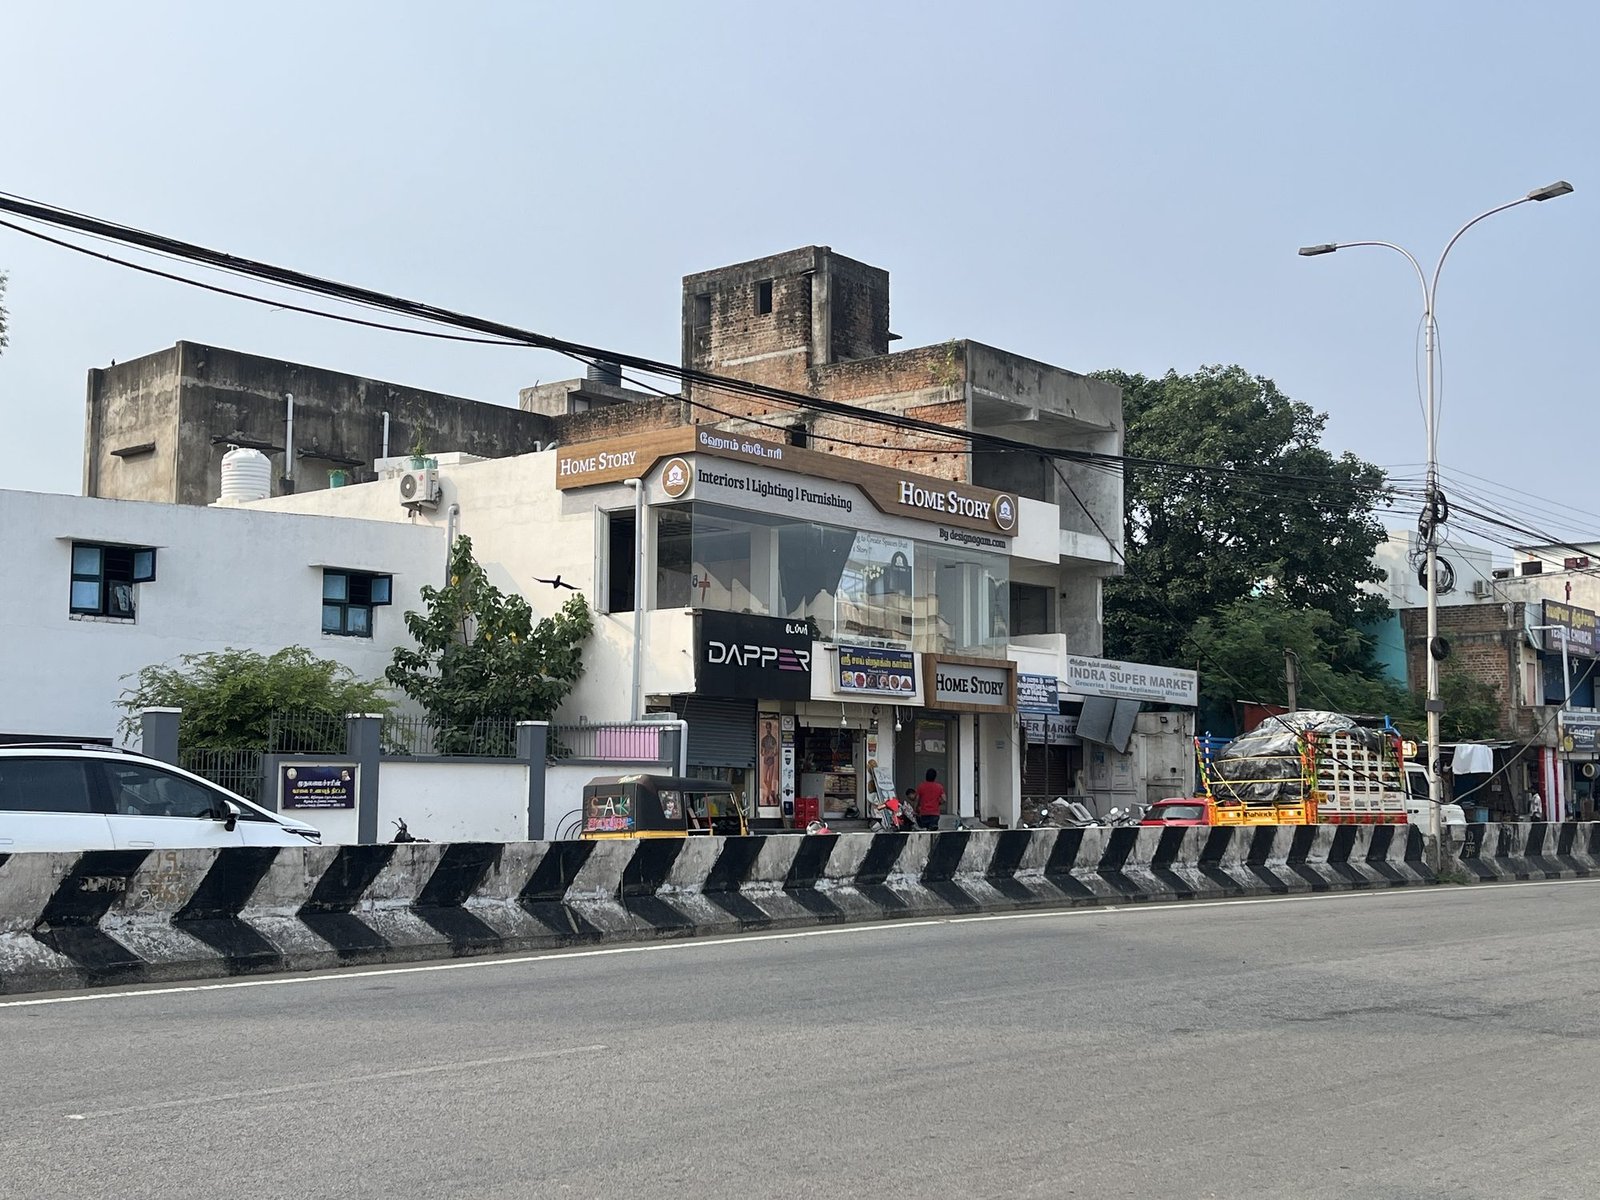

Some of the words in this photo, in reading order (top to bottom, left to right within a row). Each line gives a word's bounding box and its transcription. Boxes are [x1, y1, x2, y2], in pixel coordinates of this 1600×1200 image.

[700, 432, 739, 451] ஹோம்
[741, 441, 782, 460] ஸ்டோரி
[698, 469, 744, 490] Interiors
[752, 479, 794, 502] Lighting
[801, 489, 852, 513] Furnishing
[939, 528, 949, 541] By
[950, 529, 1006, 548] designogam.com
[708, 640, 810, 672] DAPPER
[1070, 667, 1106, 681] INDRA
[1110, 671, 1146, 686] SUPER
[1150, 676, 1194, 691] MARKET
[1075, 680, 1104, 689] Groceries
